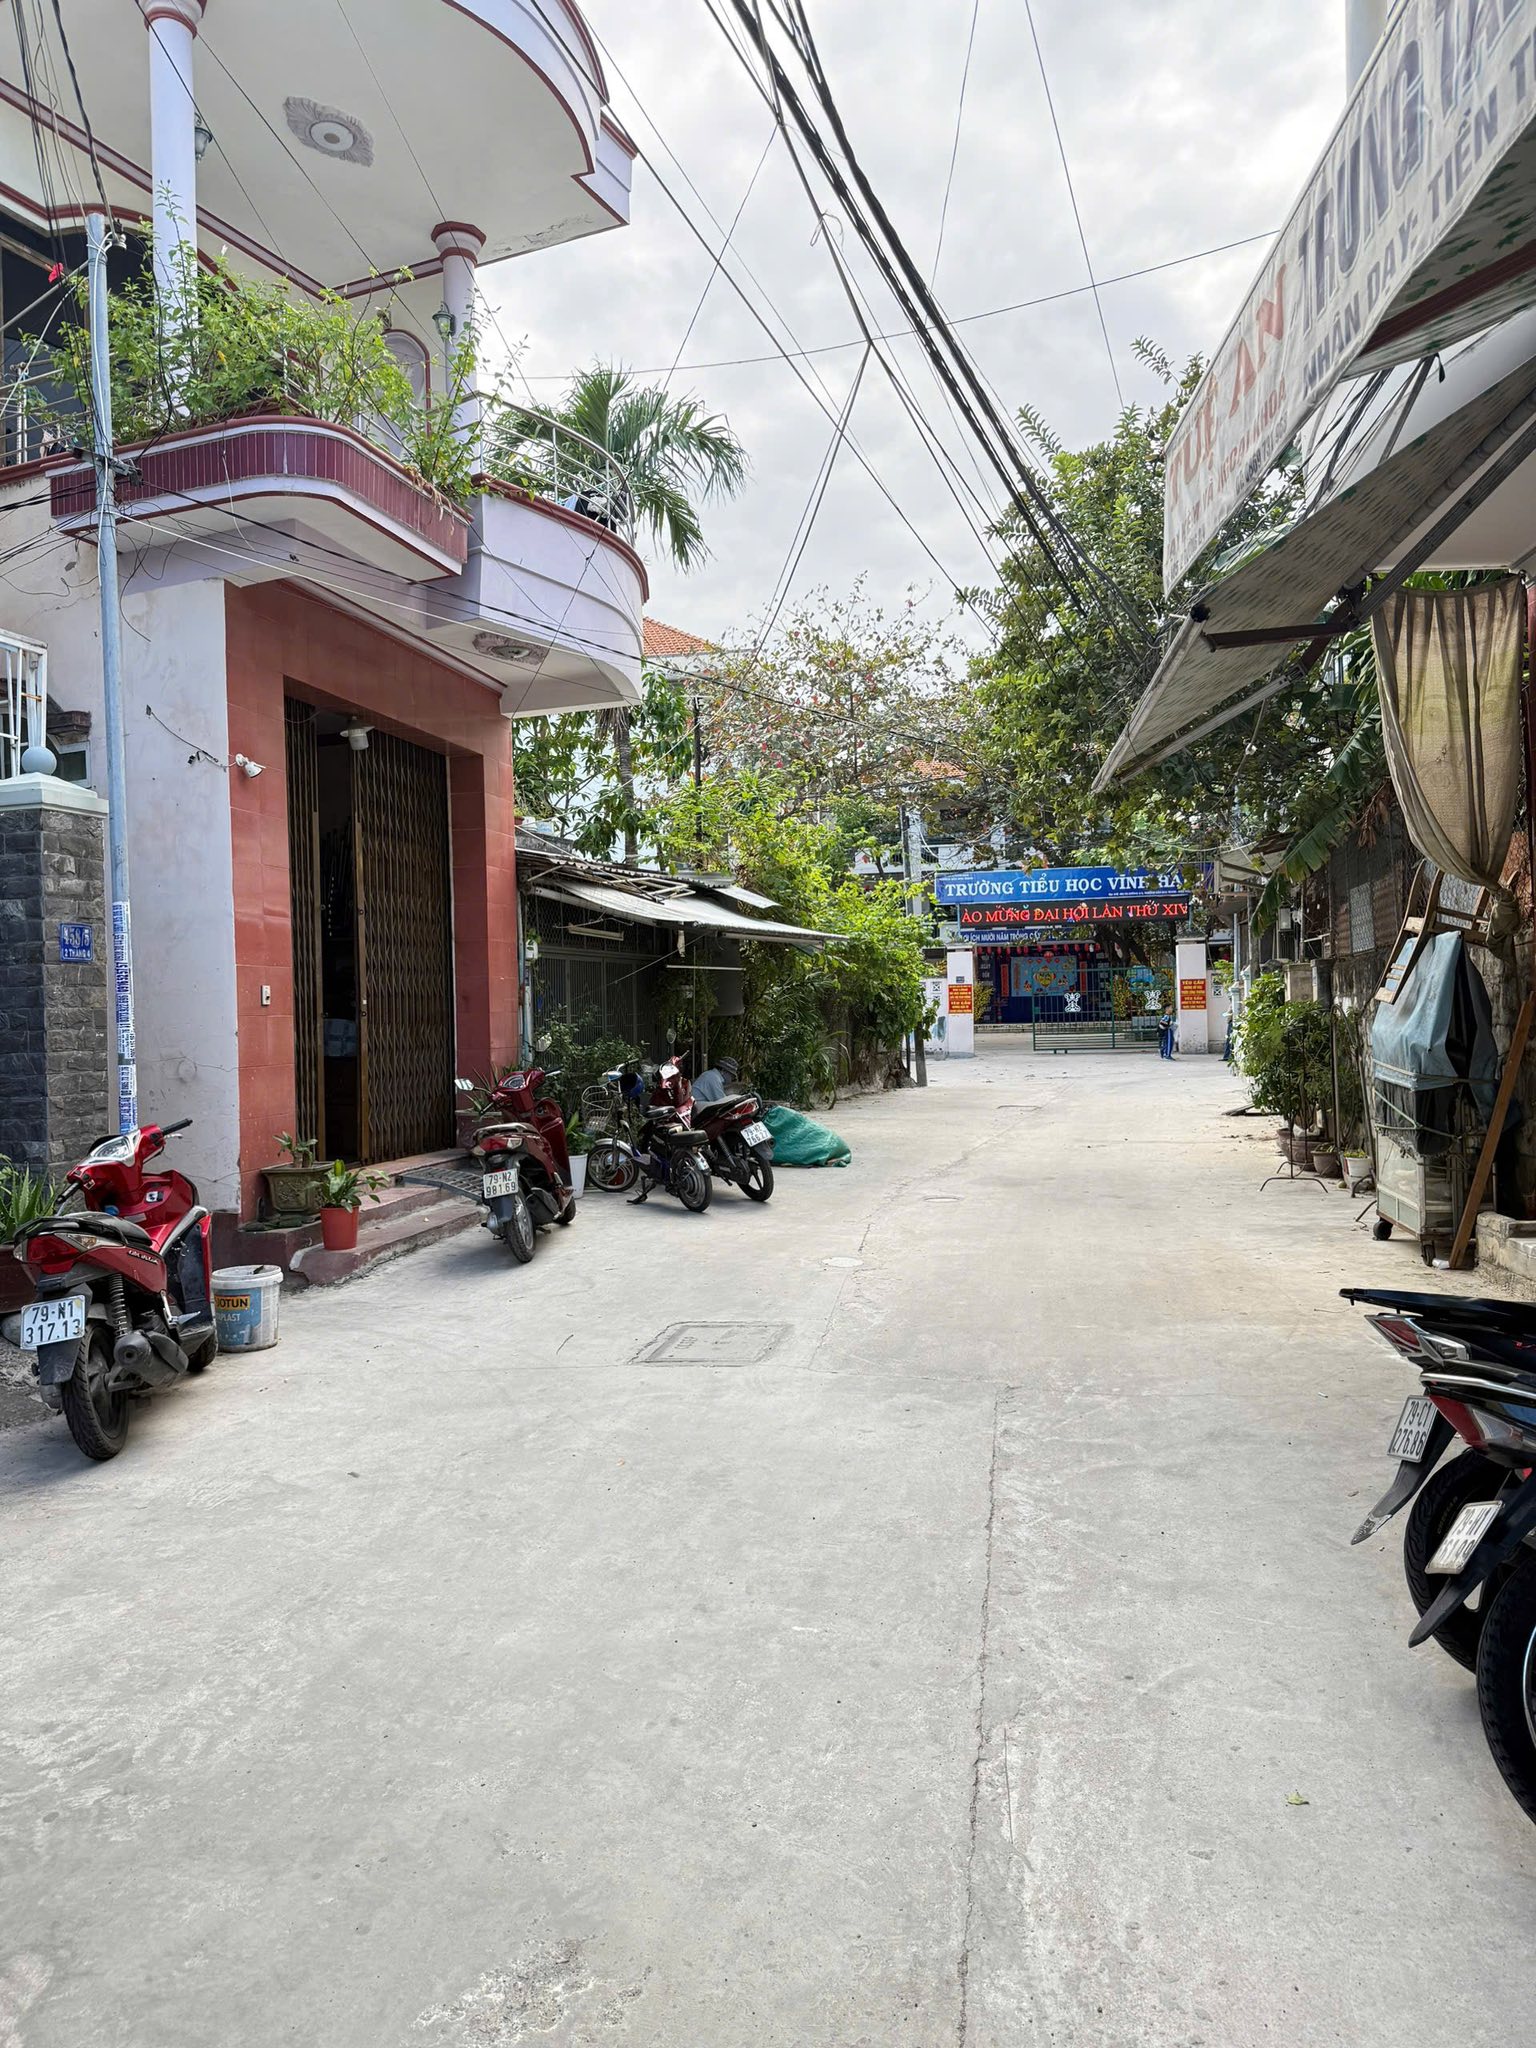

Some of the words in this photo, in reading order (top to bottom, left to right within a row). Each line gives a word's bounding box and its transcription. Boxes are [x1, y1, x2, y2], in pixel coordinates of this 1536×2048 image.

[1298, 39, 1424, 341] TRUNG
[1229, 264, 1287, 418] AN
[945, 879, 1014, 896] TRƯỜNG
[1019, 873, 1060, 893] TIỂU
[1065, 878, 1103, 894] HỌC
[986, 905, 1031, 923] MỪNG
[1034, 908, 1060, 922] ĐẠI
[1162, 903, 1188, 916] XIV
[486, 1182, 516, 1195] 981.69
[489, 1172, 512, 1185] 79-N2
[32, 1301, 74, 1324] 79-N1
[216, 1297, 248, 1308] JOTUN
[26, 1319, 80, 1344] 317.13
[1404, 1401, 1432, 1426] 79-C1
[1392, 1428, 1427, 1457] 276.86
